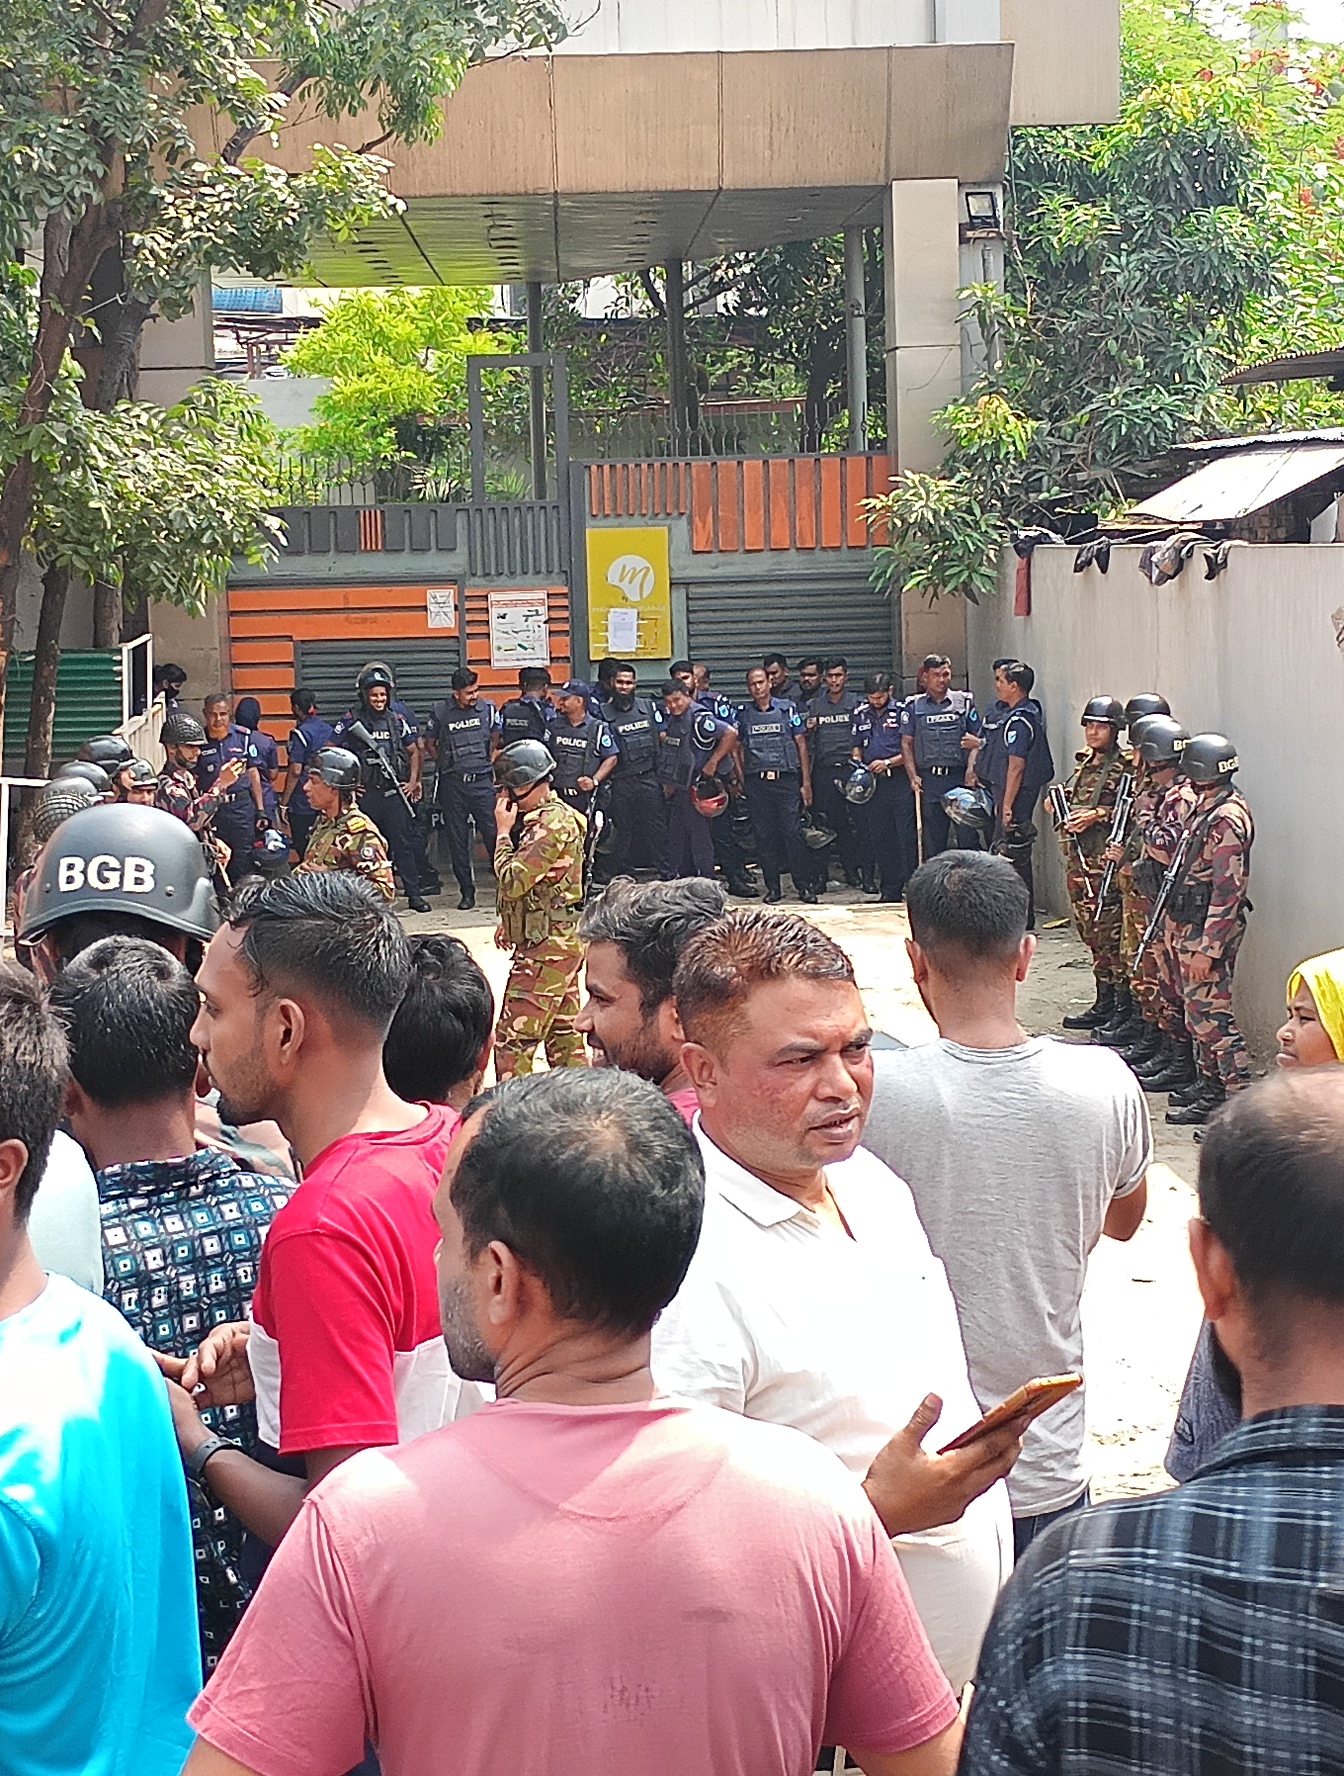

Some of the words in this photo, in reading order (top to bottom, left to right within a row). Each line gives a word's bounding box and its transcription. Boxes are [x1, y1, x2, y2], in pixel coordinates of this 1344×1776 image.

[448, 718, 481, 731] POLICE
[618, 720, 650, 733] POLICE
[556, 736, 587, 748] POLICE
[58, 855, 155, 893] BGB
